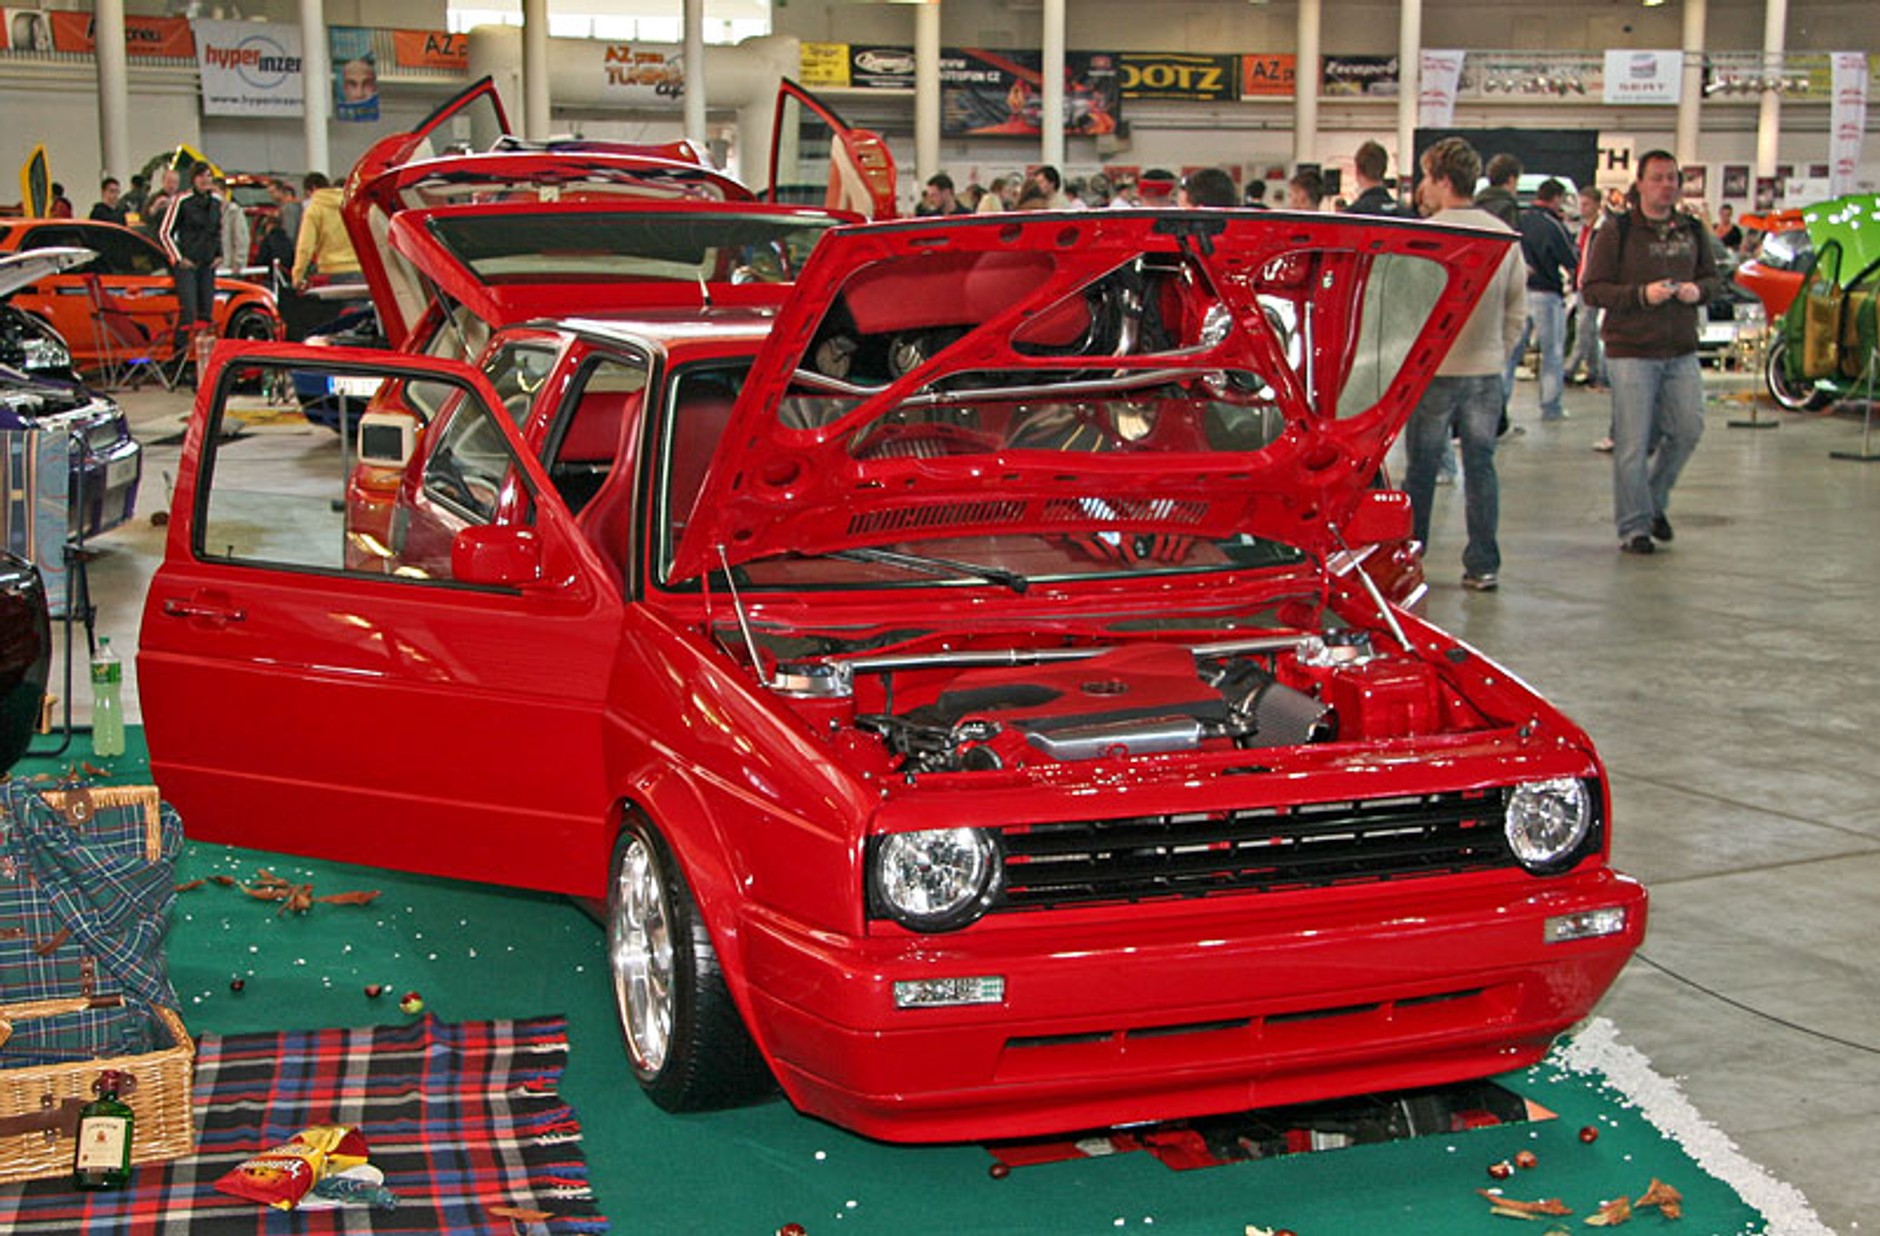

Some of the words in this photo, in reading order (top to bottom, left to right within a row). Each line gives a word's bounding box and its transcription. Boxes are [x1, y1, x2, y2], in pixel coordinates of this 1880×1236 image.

[425, 34, 454, 55] AZ
[605, 44, 632, 63] AZ
[1253, 60, 1280, 80] AZ
